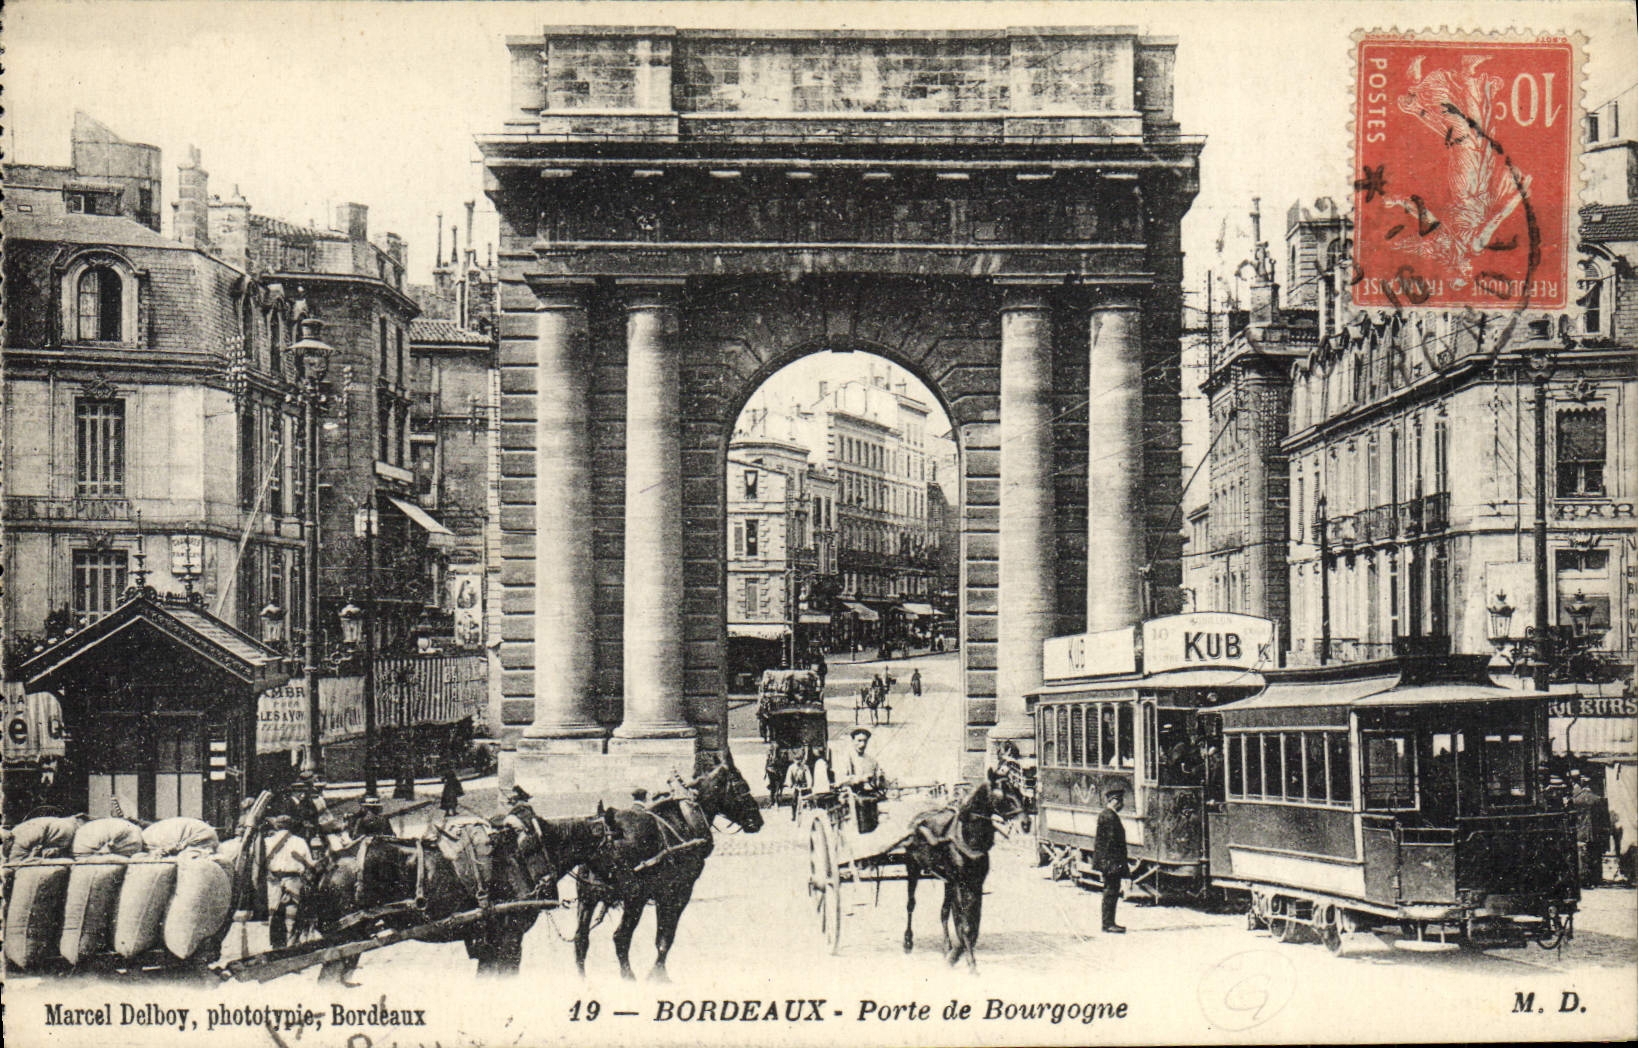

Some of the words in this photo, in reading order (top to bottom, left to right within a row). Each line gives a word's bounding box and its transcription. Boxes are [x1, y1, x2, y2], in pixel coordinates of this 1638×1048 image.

[1366, 57, 1388, 143] POSTES
[1184, 631, 1243, 662] KUB
[1257, 642, 1273, 663] K
